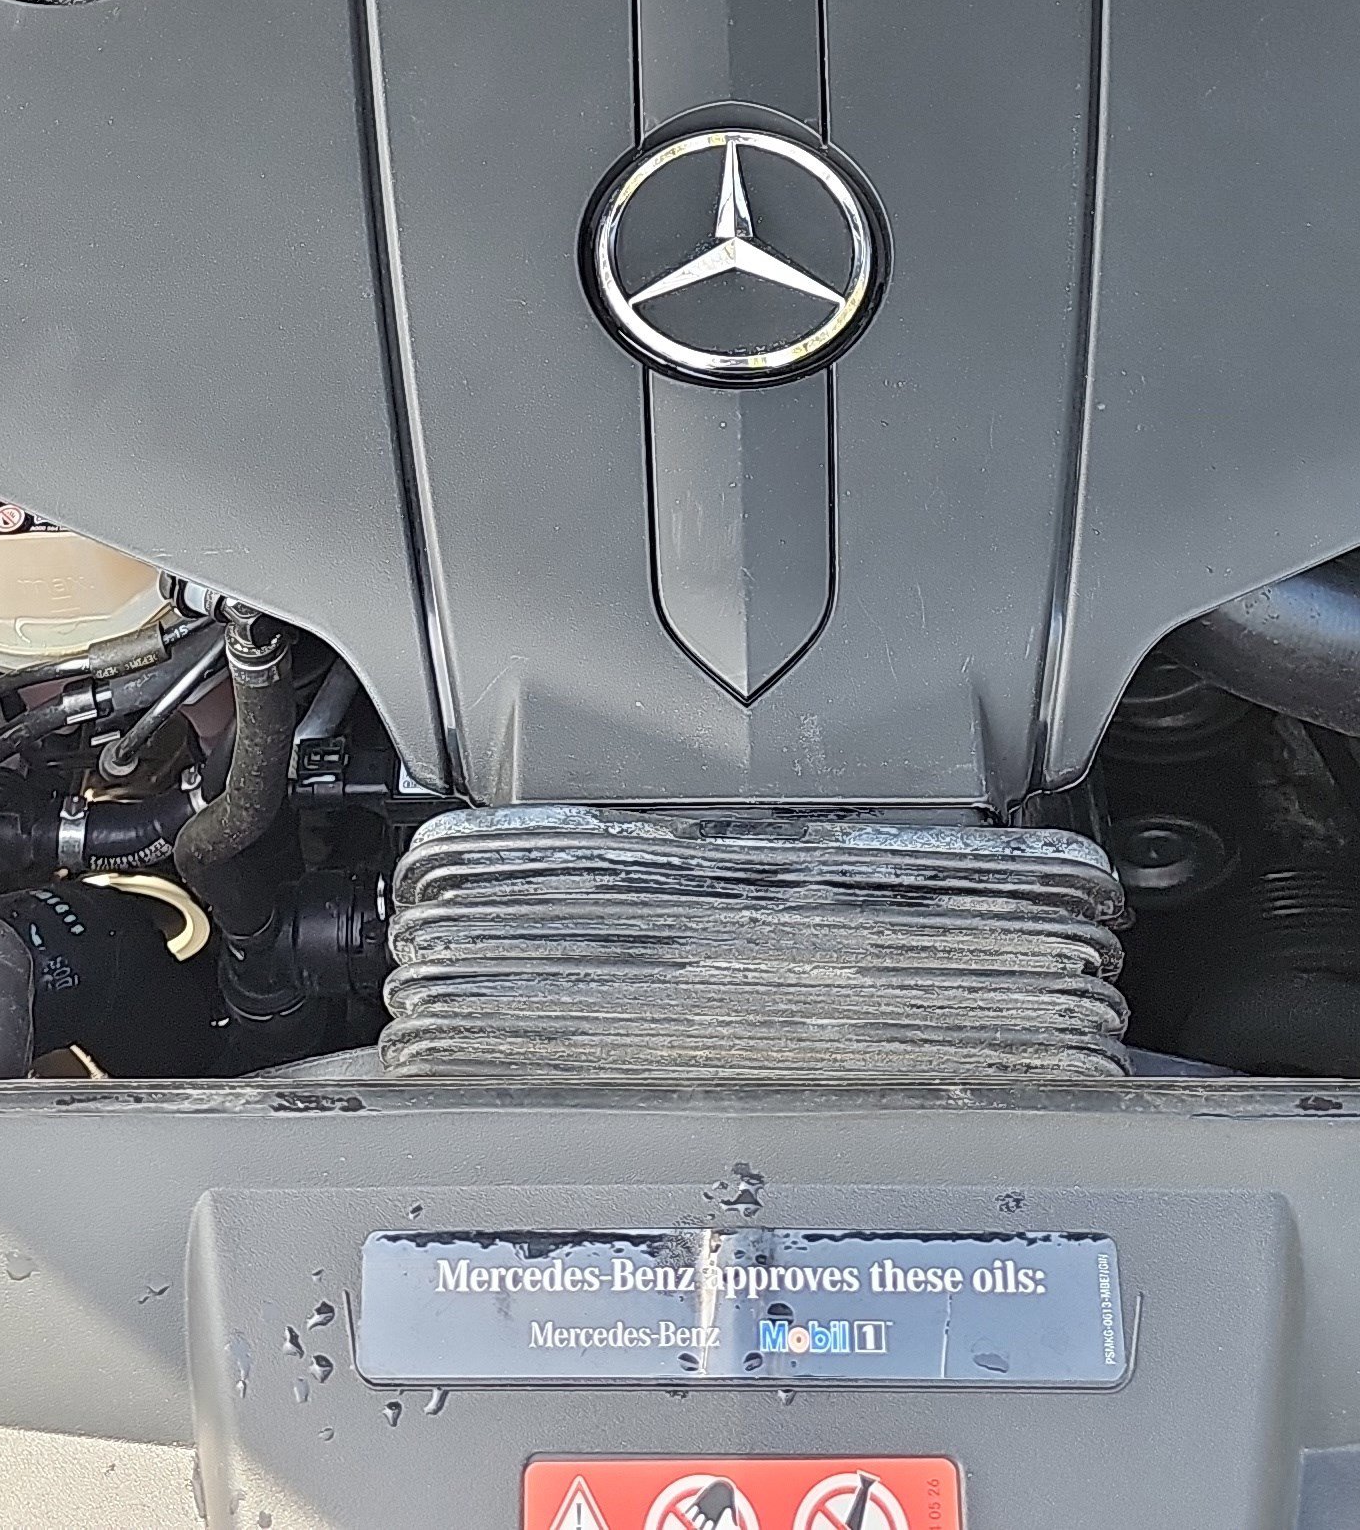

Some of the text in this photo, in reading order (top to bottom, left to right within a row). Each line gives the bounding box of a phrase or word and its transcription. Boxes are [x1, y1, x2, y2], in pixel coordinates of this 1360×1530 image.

[435, 1258, 1046, 1299] Mercedes-Benz approves these oils:
[528, 1320, 720, 1349] Mercedes-Benz
[759, 1320, 851, 1354] Mobil
[927, 1479, 941, 1496] 26
[928, 1502, 942, 1520] 05
